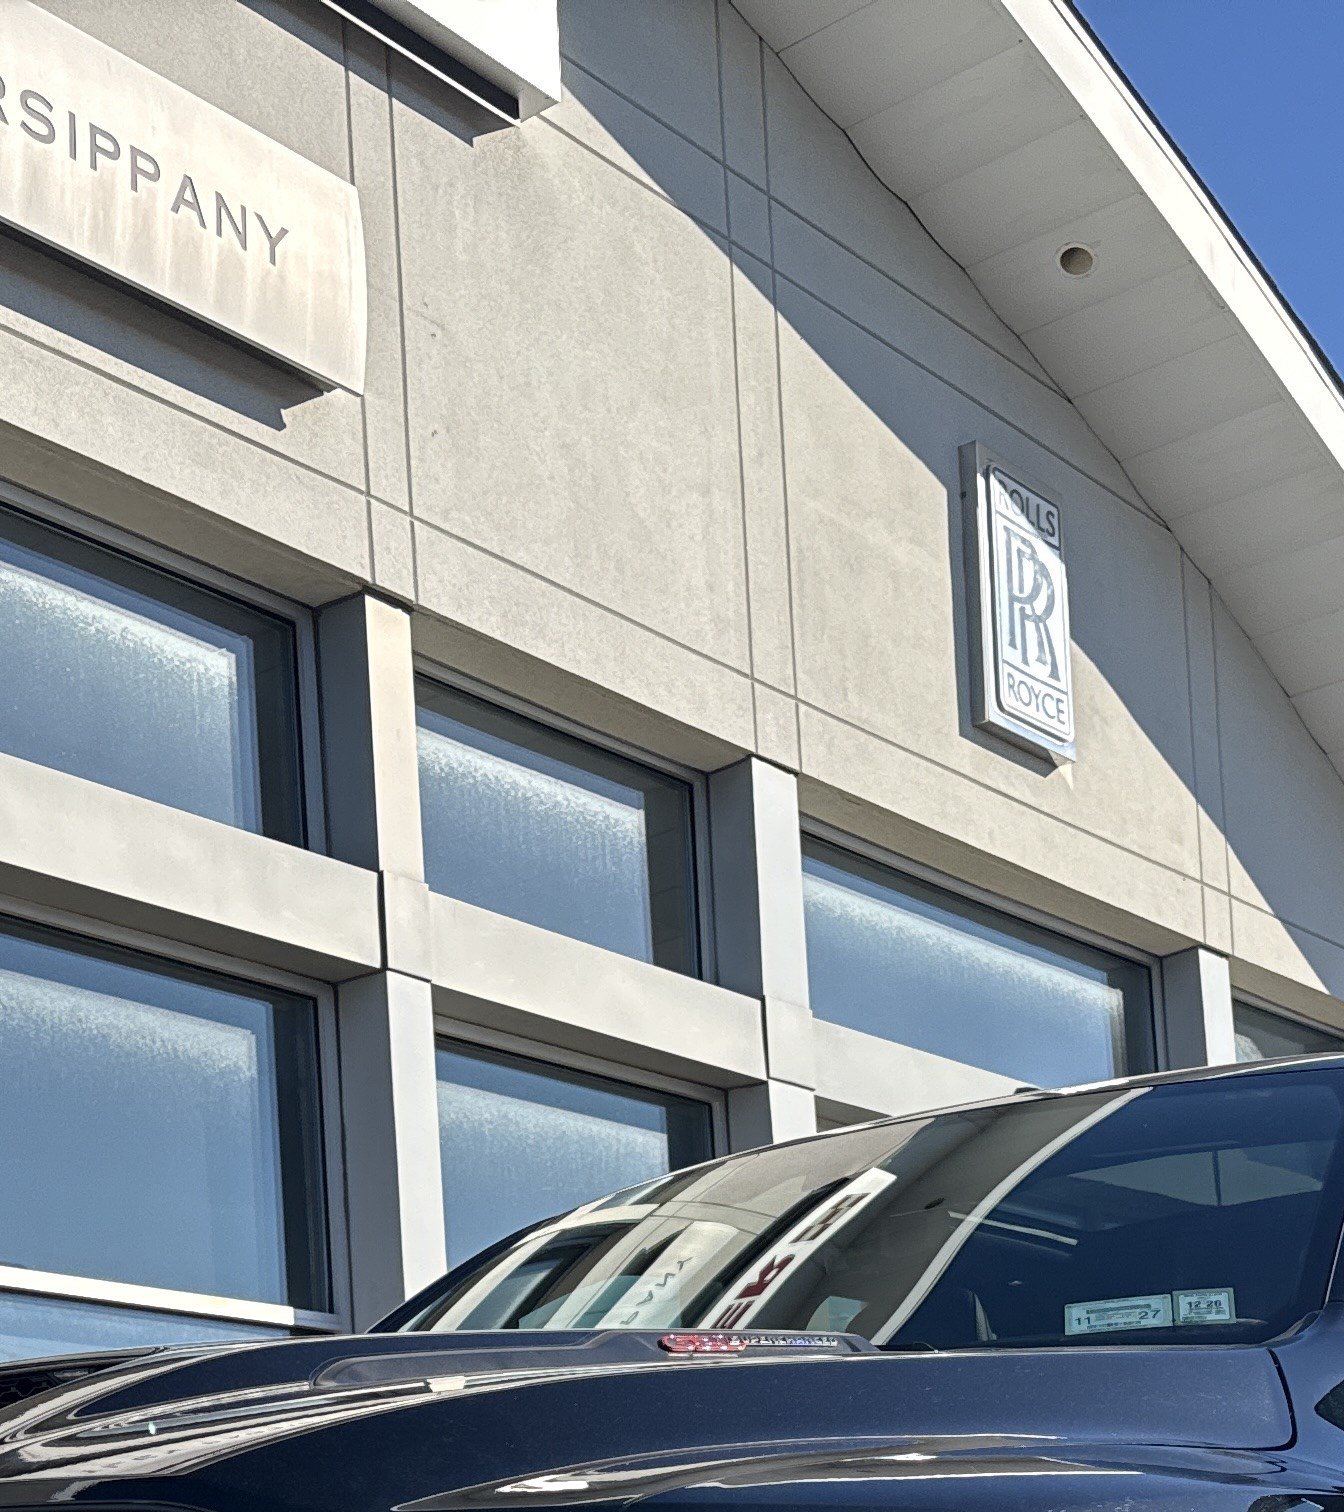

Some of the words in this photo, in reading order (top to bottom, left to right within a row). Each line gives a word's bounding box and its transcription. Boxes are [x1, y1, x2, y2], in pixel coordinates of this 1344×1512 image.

[995, 478, 1056, 539] ROLLS
[1006, 672, 1066, 726] ROYCE
[1074, 1316, 1092, 1326] 11
[1138, 1309, 1162, 1320] 27
